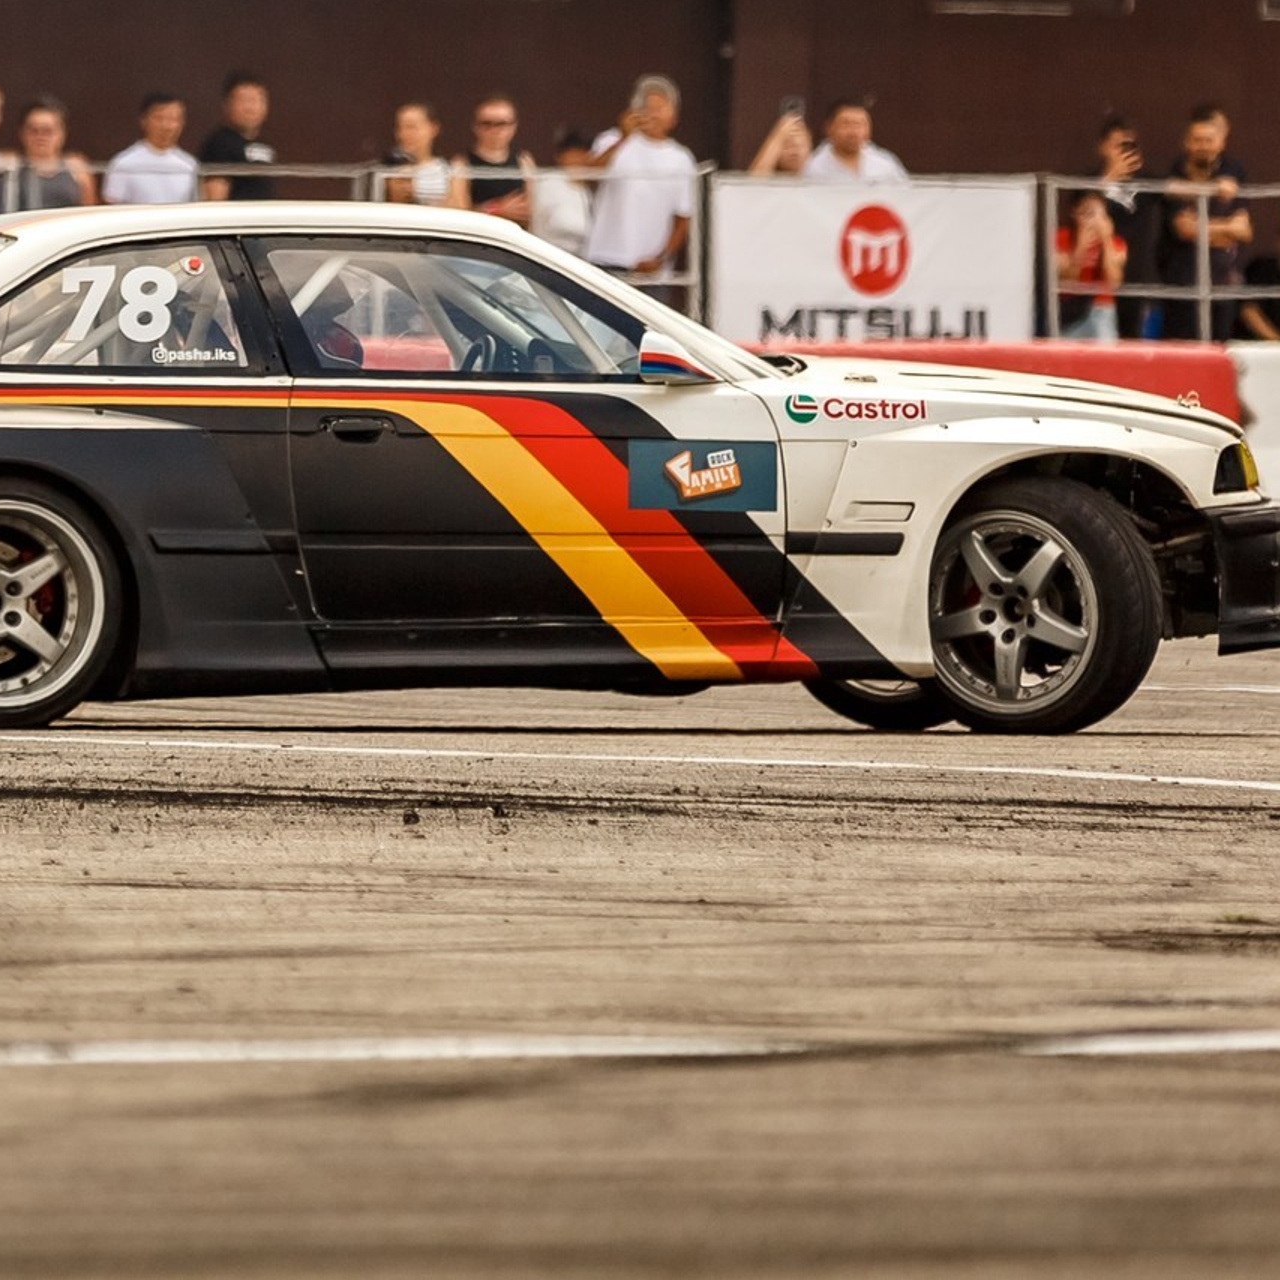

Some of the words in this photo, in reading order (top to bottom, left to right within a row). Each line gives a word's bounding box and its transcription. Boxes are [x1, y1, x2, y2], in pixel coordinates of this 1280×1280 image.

[61, 265, 178, 342] 78
[760, 307, 987, 341] MITSUJI
[824, 399, 926, 419] Castrol
